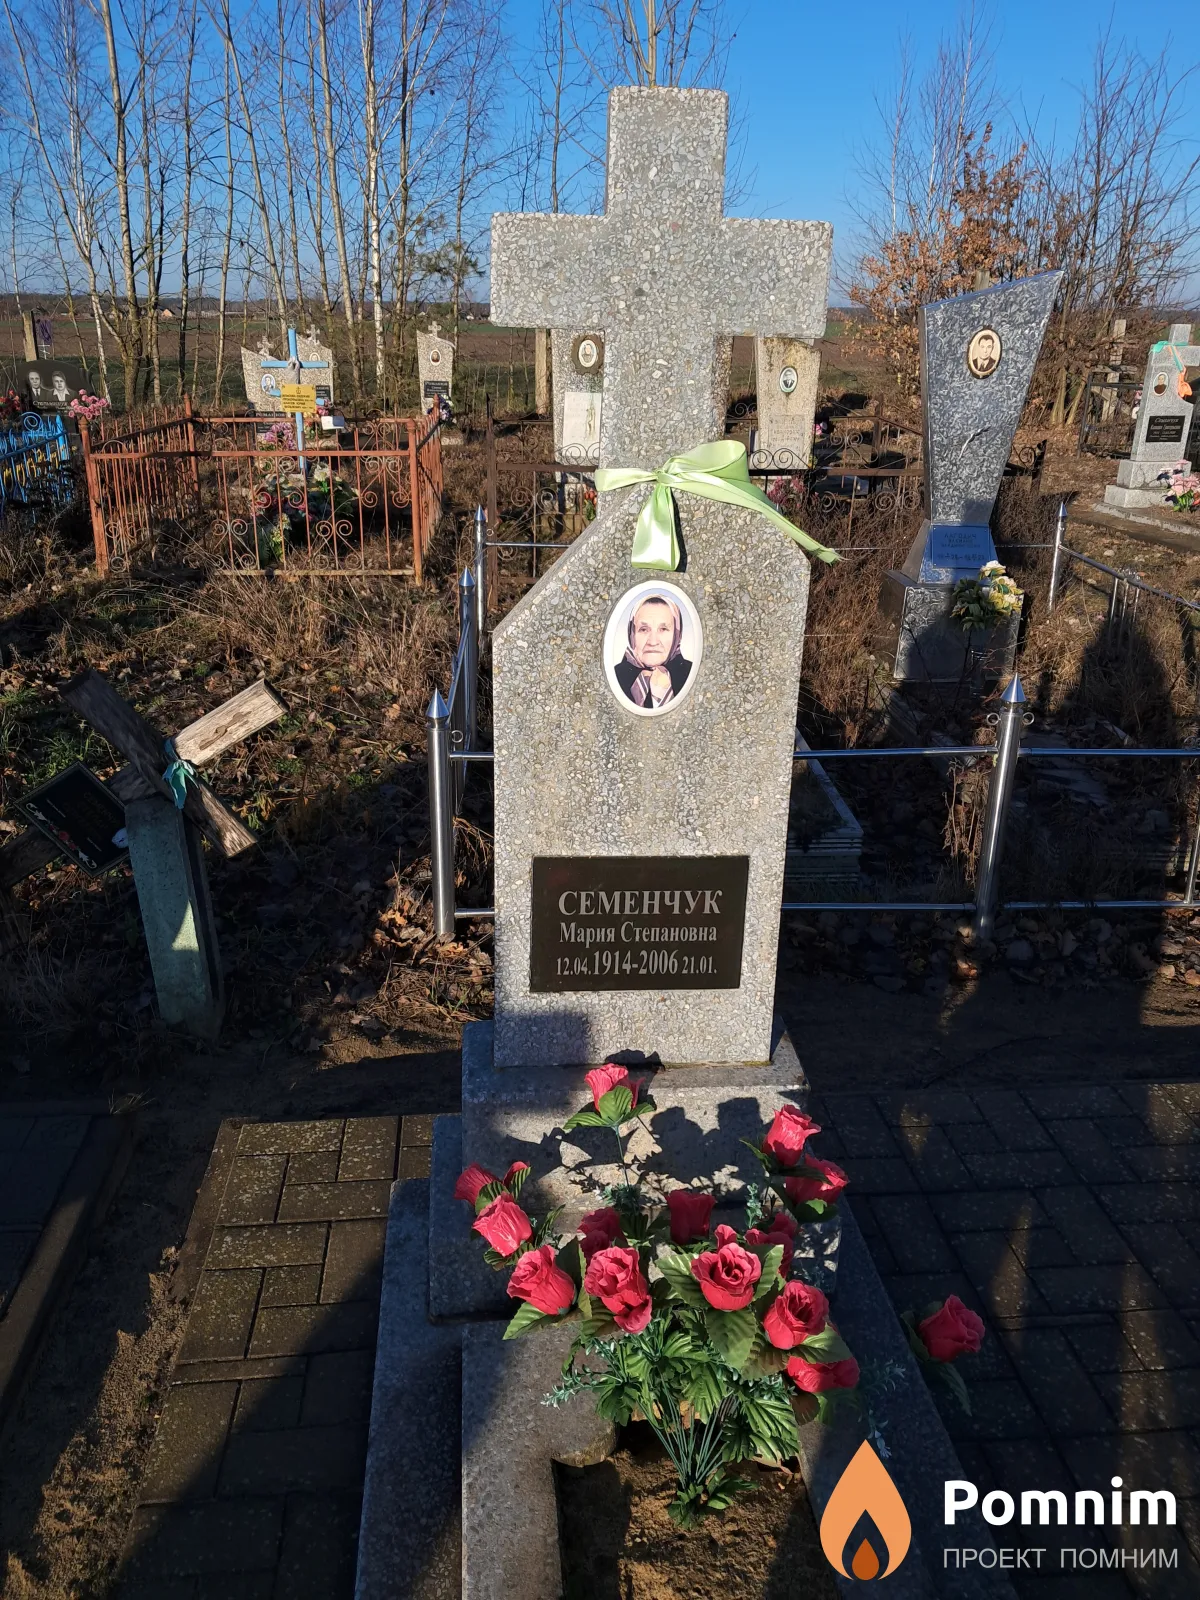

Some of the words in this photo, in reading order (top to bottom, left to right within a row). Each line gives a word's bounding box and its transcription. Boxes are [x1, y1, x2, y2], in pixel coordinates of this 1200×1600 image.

[558, 889, 723, 916] СЕМЕНЧУК
[559, 922, 615, 948] Мария
[620, 921, 717, 943] Степановна
[682, 956, 718, 974] 21.01.
